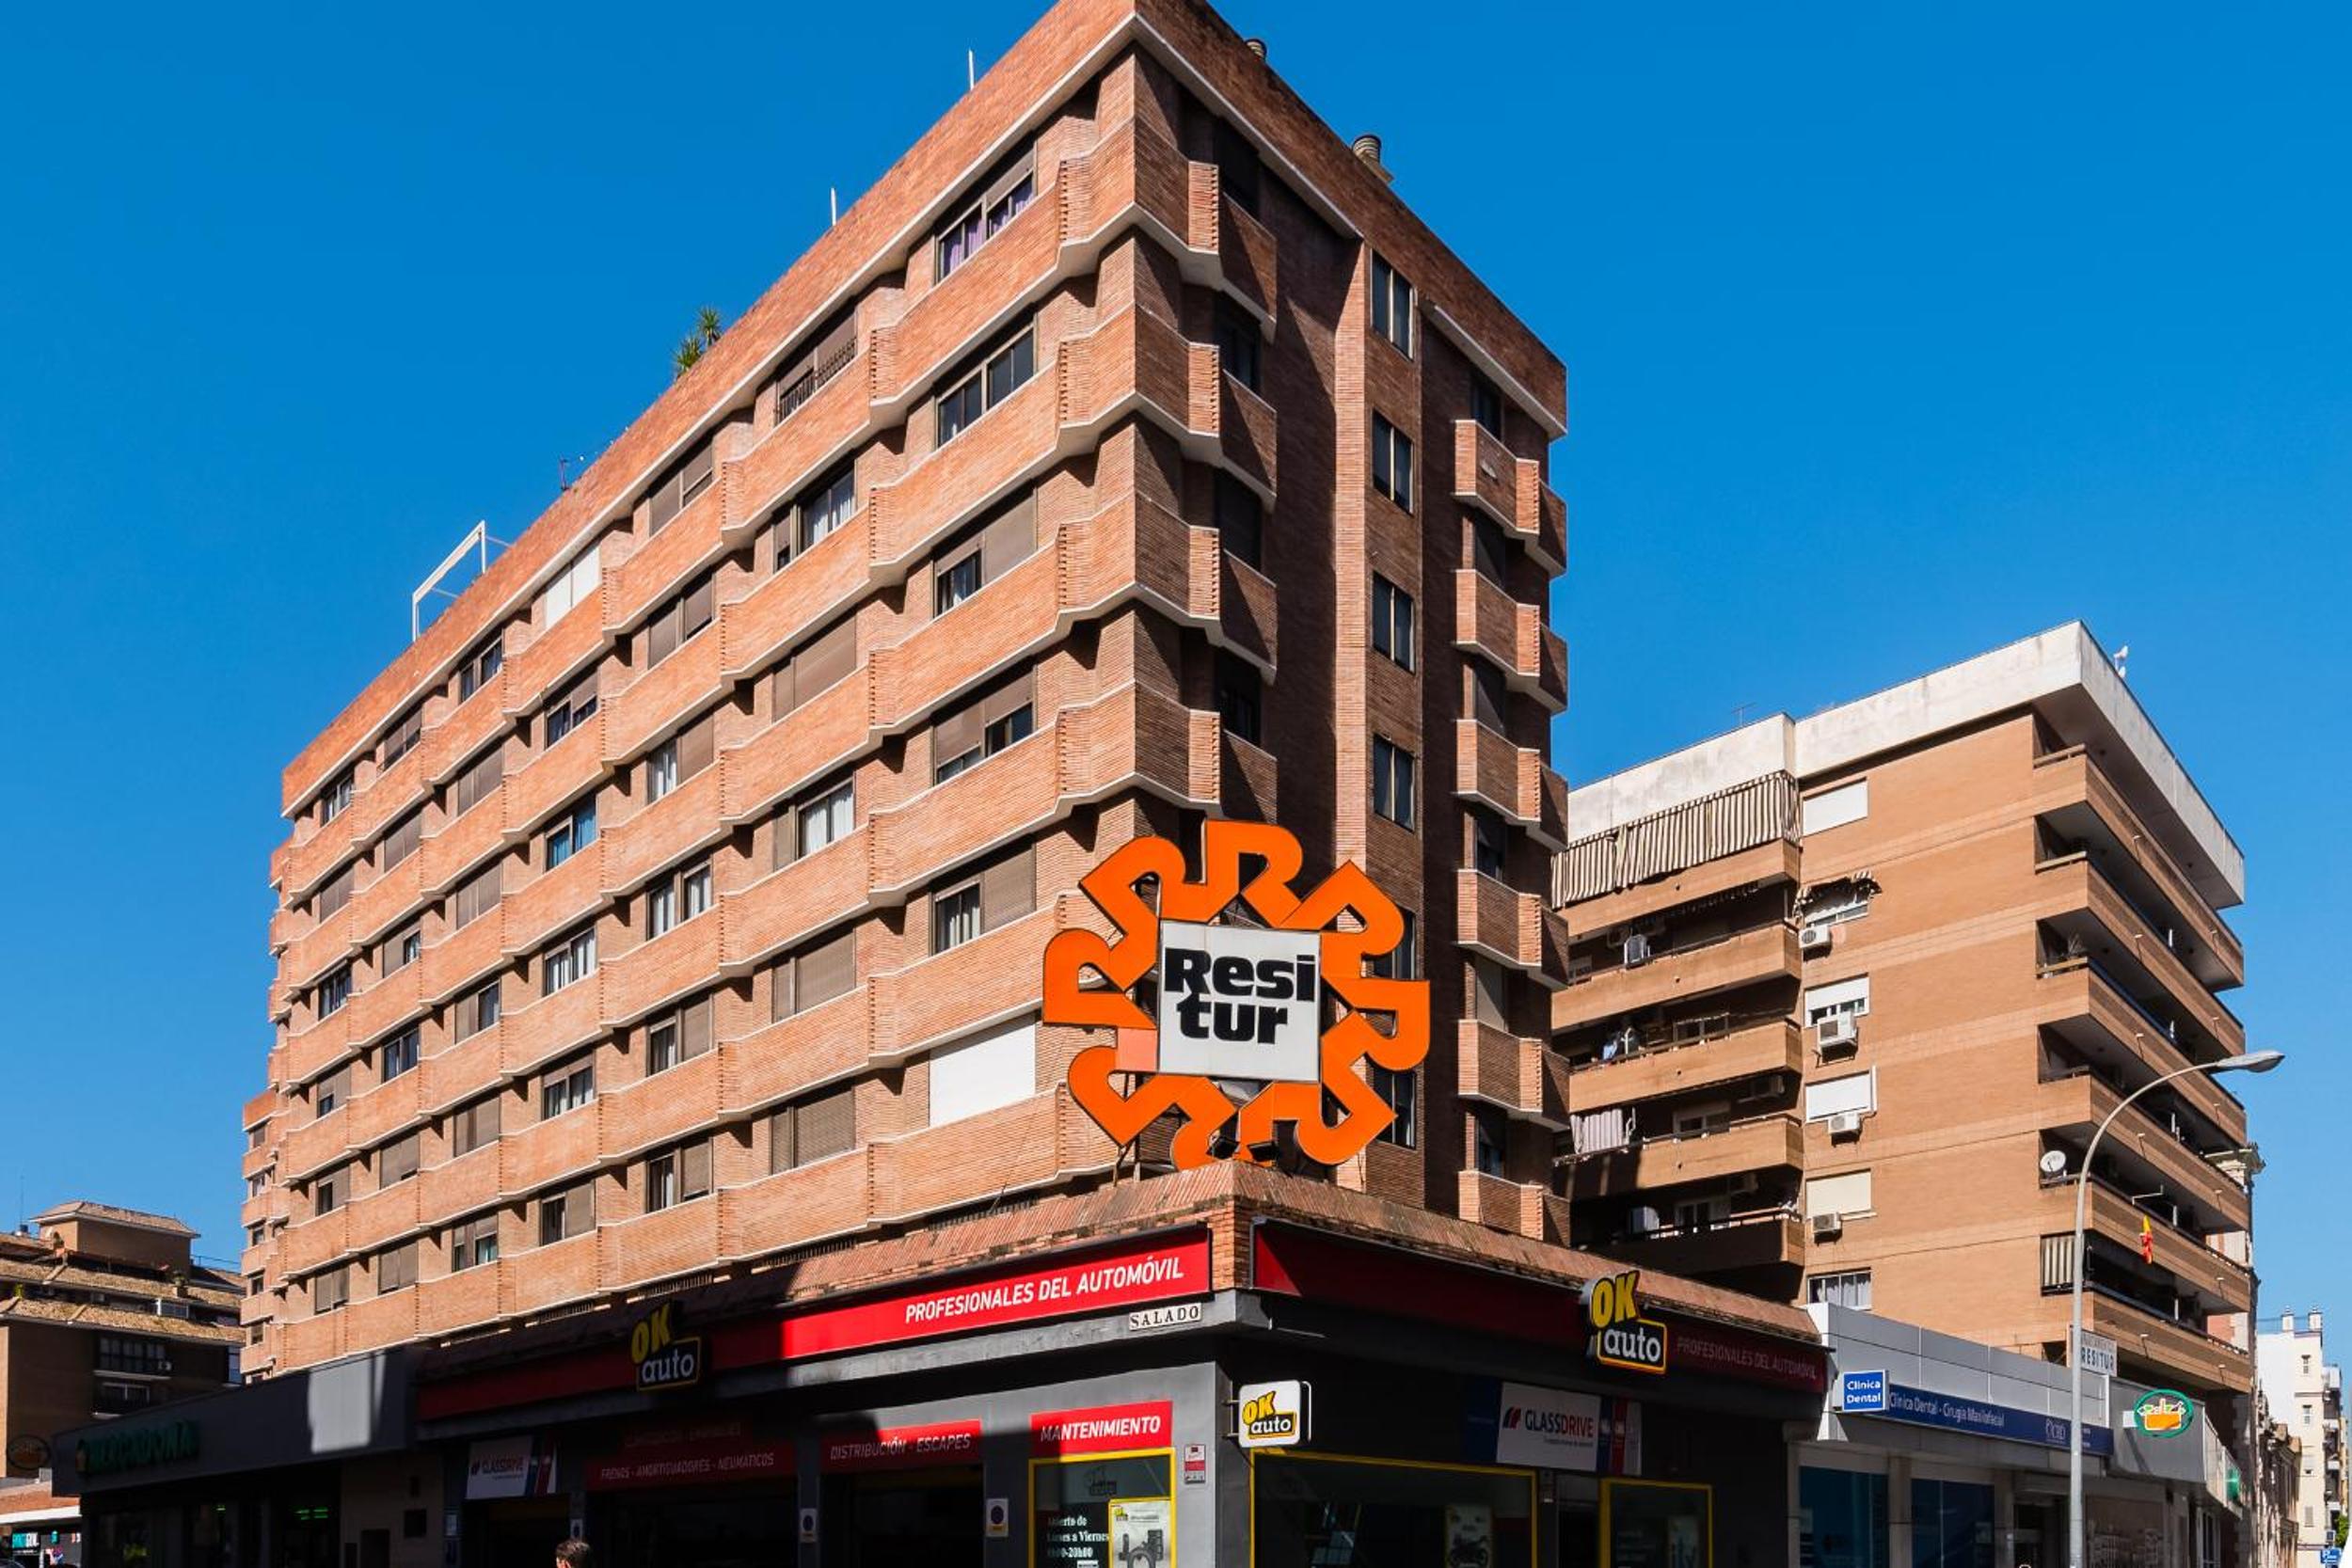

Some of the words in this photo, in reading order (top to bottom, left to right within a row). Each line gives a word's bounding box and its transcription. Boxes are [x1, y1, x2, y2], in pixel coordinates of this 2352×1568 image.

[1164, 947, 1316, 1003] Resi
[1177, 991, 1288, 1045] tur
[905, 1283, 1034, 1323] PROFESIONALES
[1039, 1276, 1072, 1302] DEL
[1076, 1256, 1184, 1294] AUTOMÓVIL
[1592, 1270, 1641, 1328] OK
[631, 1302, 673, 1364] OK
[1130, 1306, 1200, 1329] SALADO
[1603, 1326, 1662, 1363] auto
[1677, 1336, 1754, 1366] PROFESIONALES
[1754, 1352, 1770, 1370] DEL
[641, 1354, 694, 1384] auto
[1242, 1391, 1276, 1425] OK
[1846, 1392, 1881, 1403] Dental
[1041, 1416, 1161, 1442] MANTENIMIENTO
[1250, 1417, 1292, 1433] auto
[1525, 1409, 1594, 1437] GLASSDRIVE
[831, 1436, 907, 1460] DISTRIBUCIÓN
[916, 1433, 972, 1453] ESCAPES
[602, 1467, 630, 1480] FRENOS
